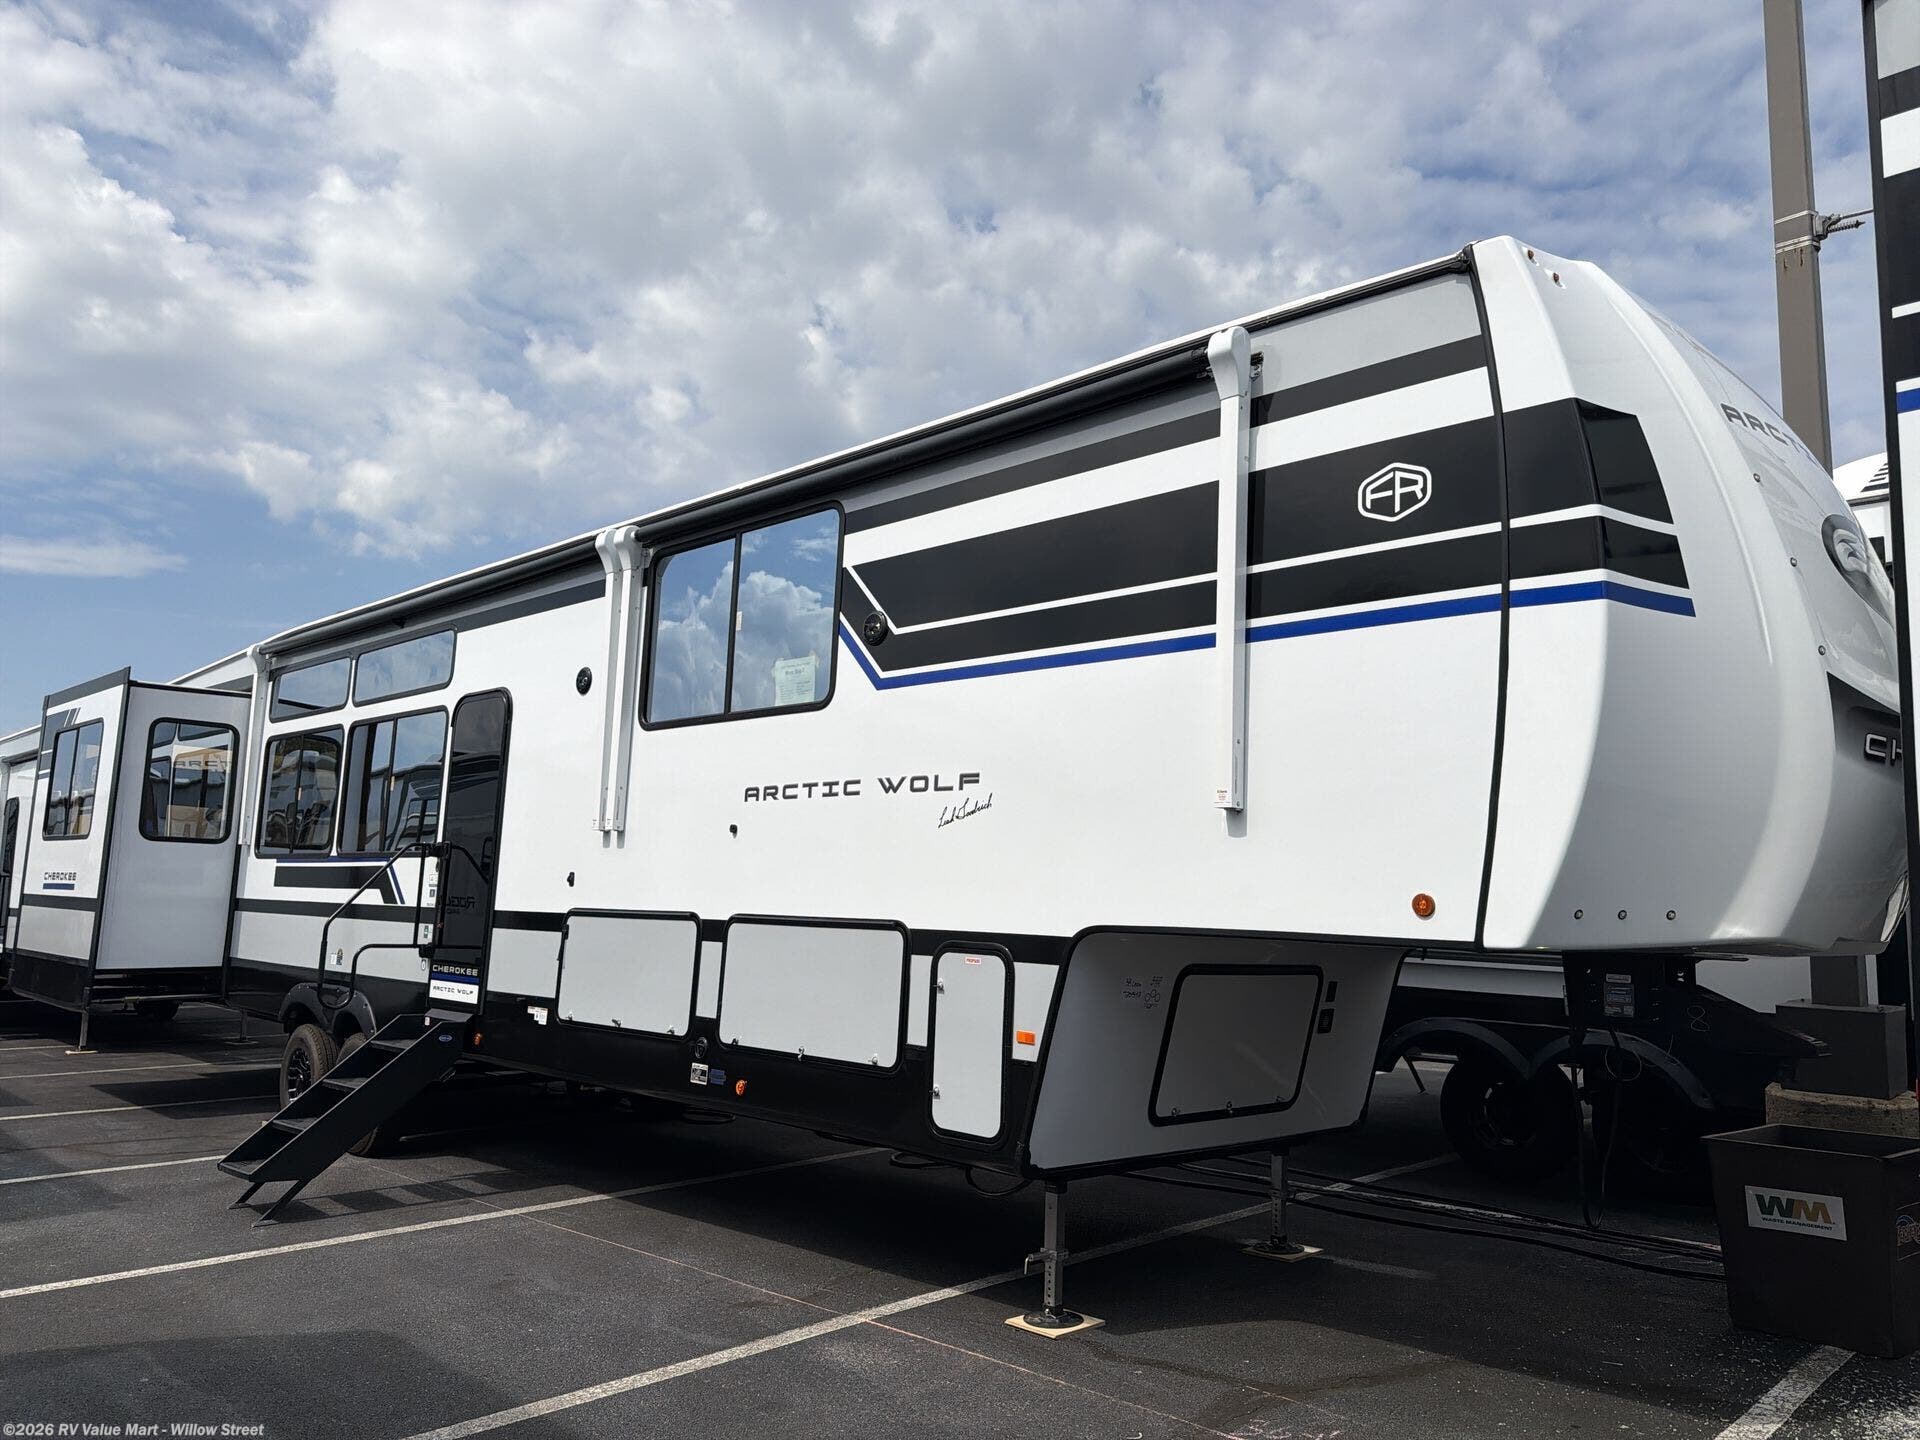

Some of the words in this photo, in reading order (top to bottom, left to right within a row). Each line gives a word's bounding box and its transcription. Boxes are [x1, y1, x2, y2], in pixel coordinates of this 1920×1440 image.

[1366, 470, 1424, 513] FR
[744, 779, 861, 802] ARCTIC
[878, 772, 980, 794] WOLF
[43, 871, 77, 881] CHEROKEE
[432, 964, 478, 977] CHEROKEE
[432, 985, 455, 994] ARCTIC
[457, 988, 474, 996] WOLF
[1755, 1193, 1832, 1225] WM
[1761, 1216, 1785, 1224] WASTE
[1785, 1220, 1833, 1231] MANAGEMENT
